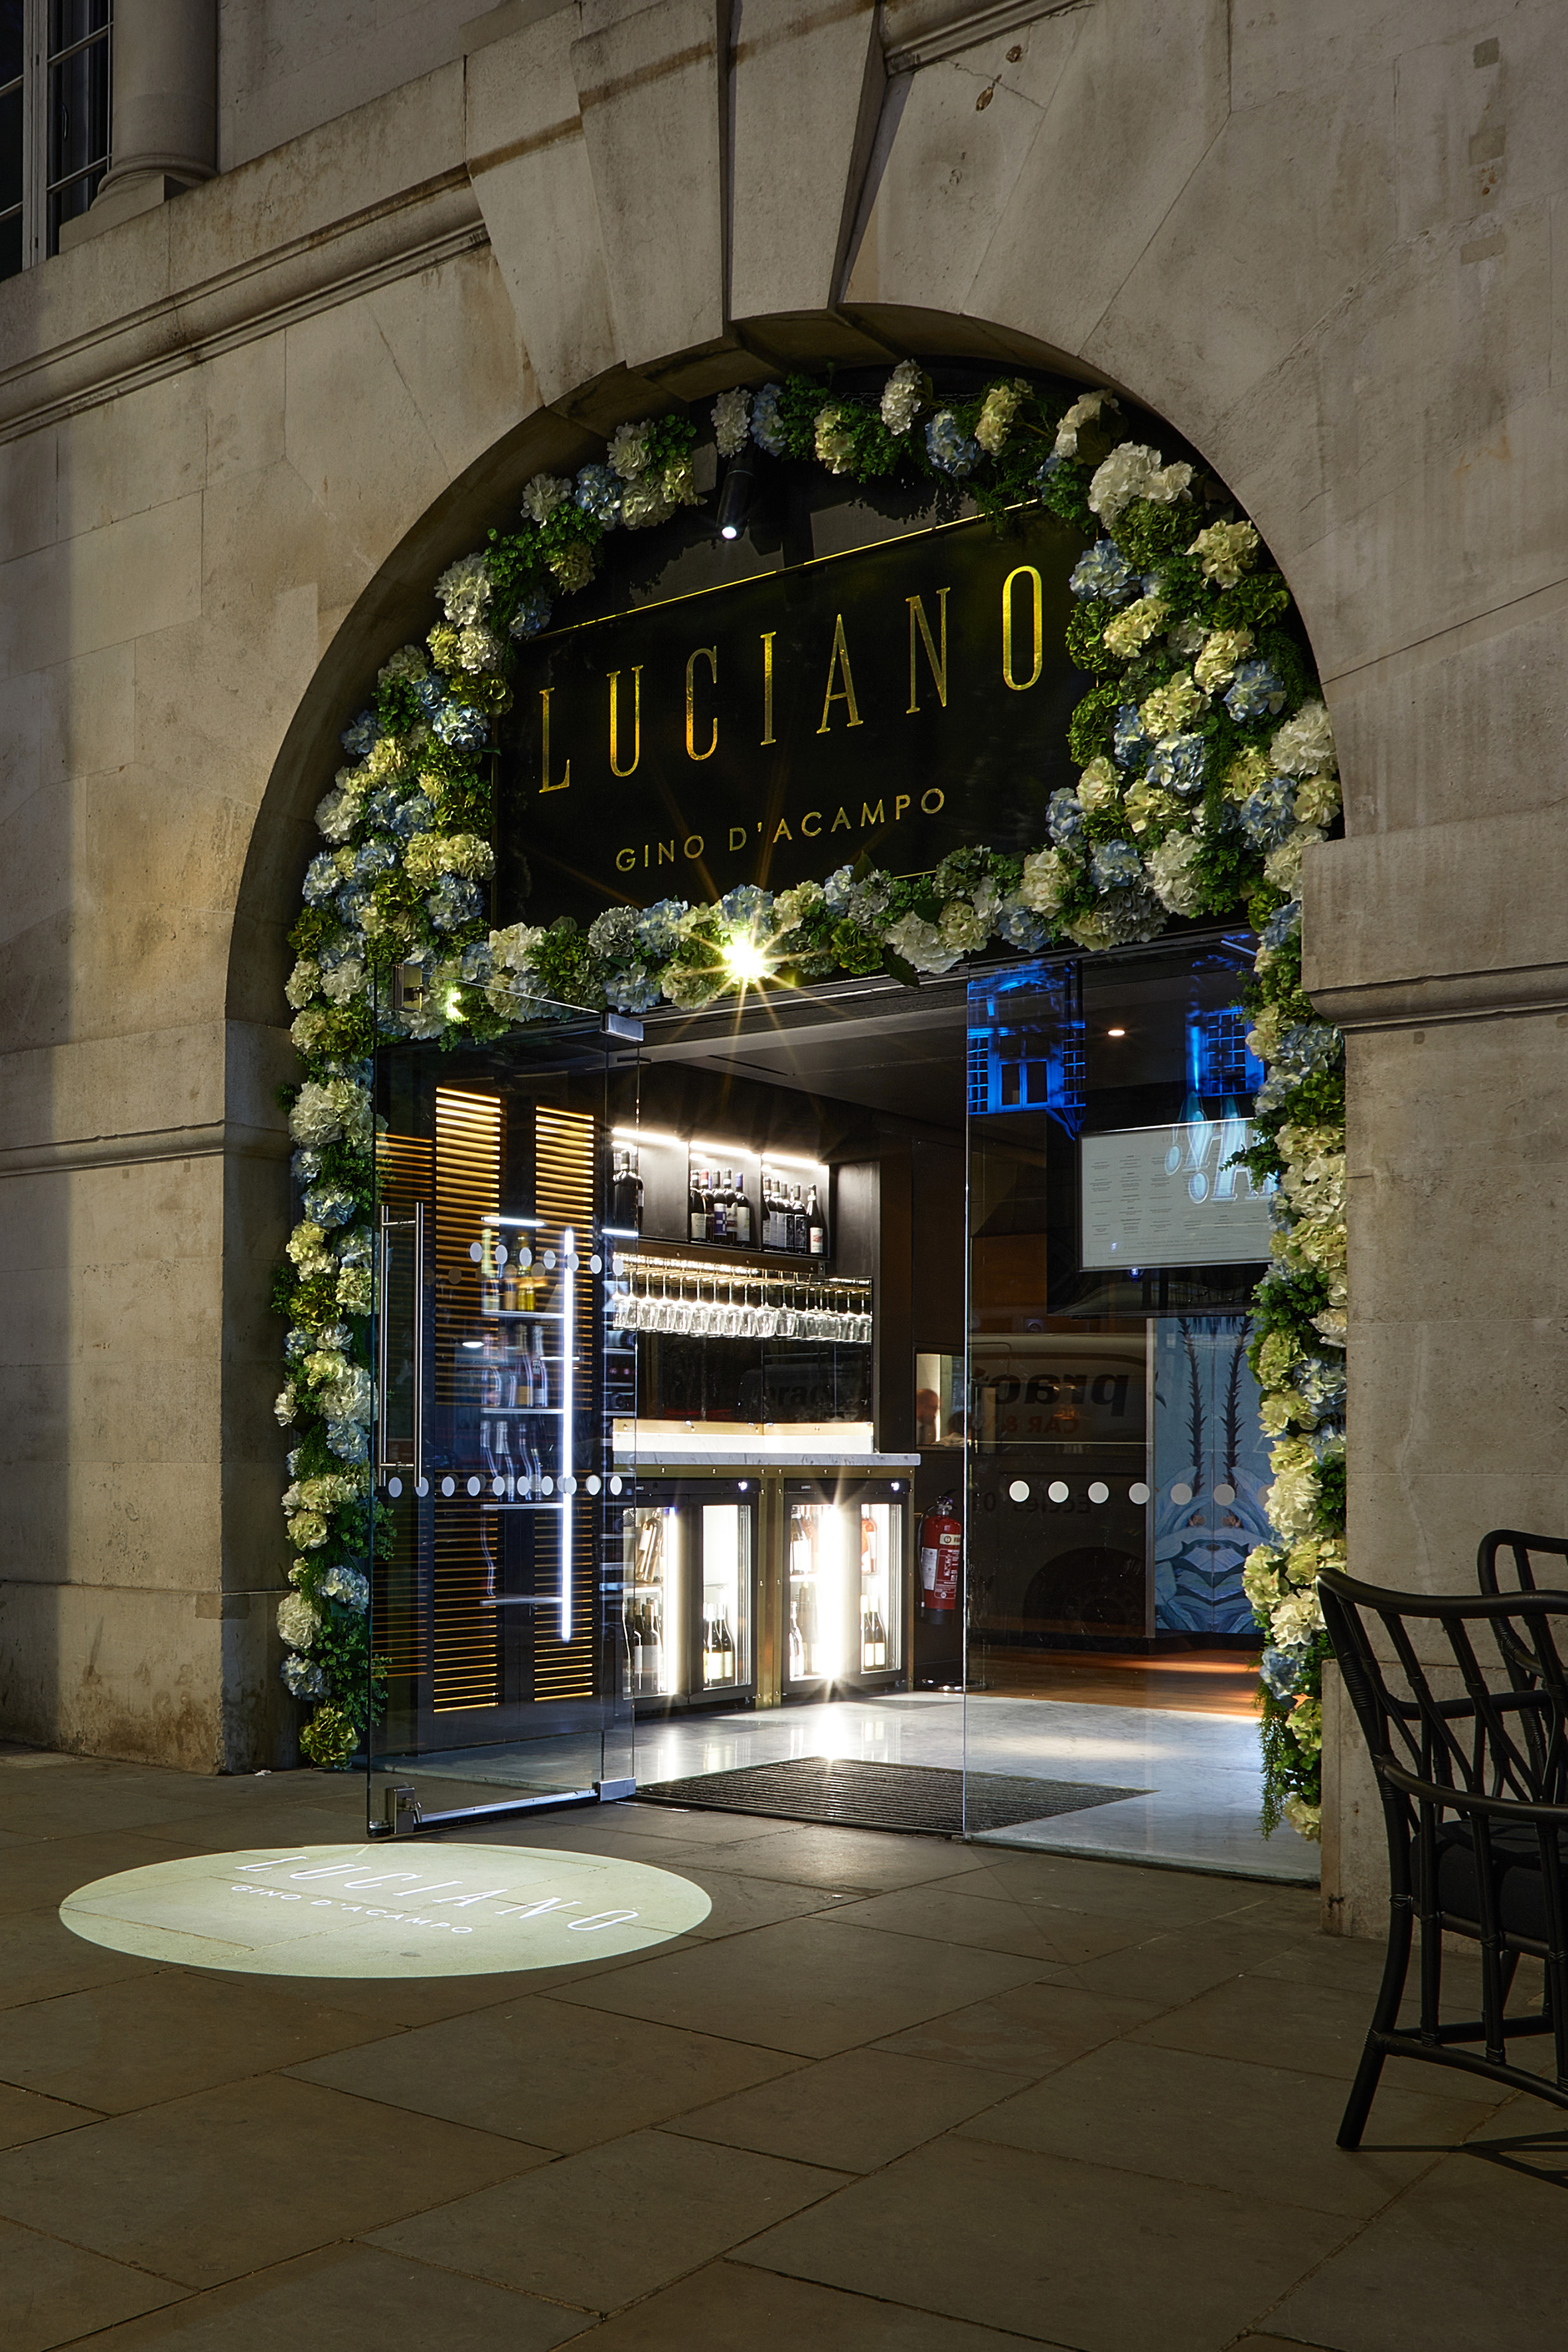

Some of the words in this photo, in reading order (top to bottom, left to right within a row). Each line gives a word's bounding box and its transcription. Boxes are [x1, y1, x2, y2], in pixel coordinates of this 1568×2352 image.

[538, 565, 1043, 793] LUCIANO
[615, 834, 704, 872] GINO
[729, 788, 945, 852] D'ACAMPO
[230, 1884, 303, 1902] GINO
[311, 1899, 473, 1934] D'ACAMPO
[235, 1855, 640, 1932] LUCIANO
